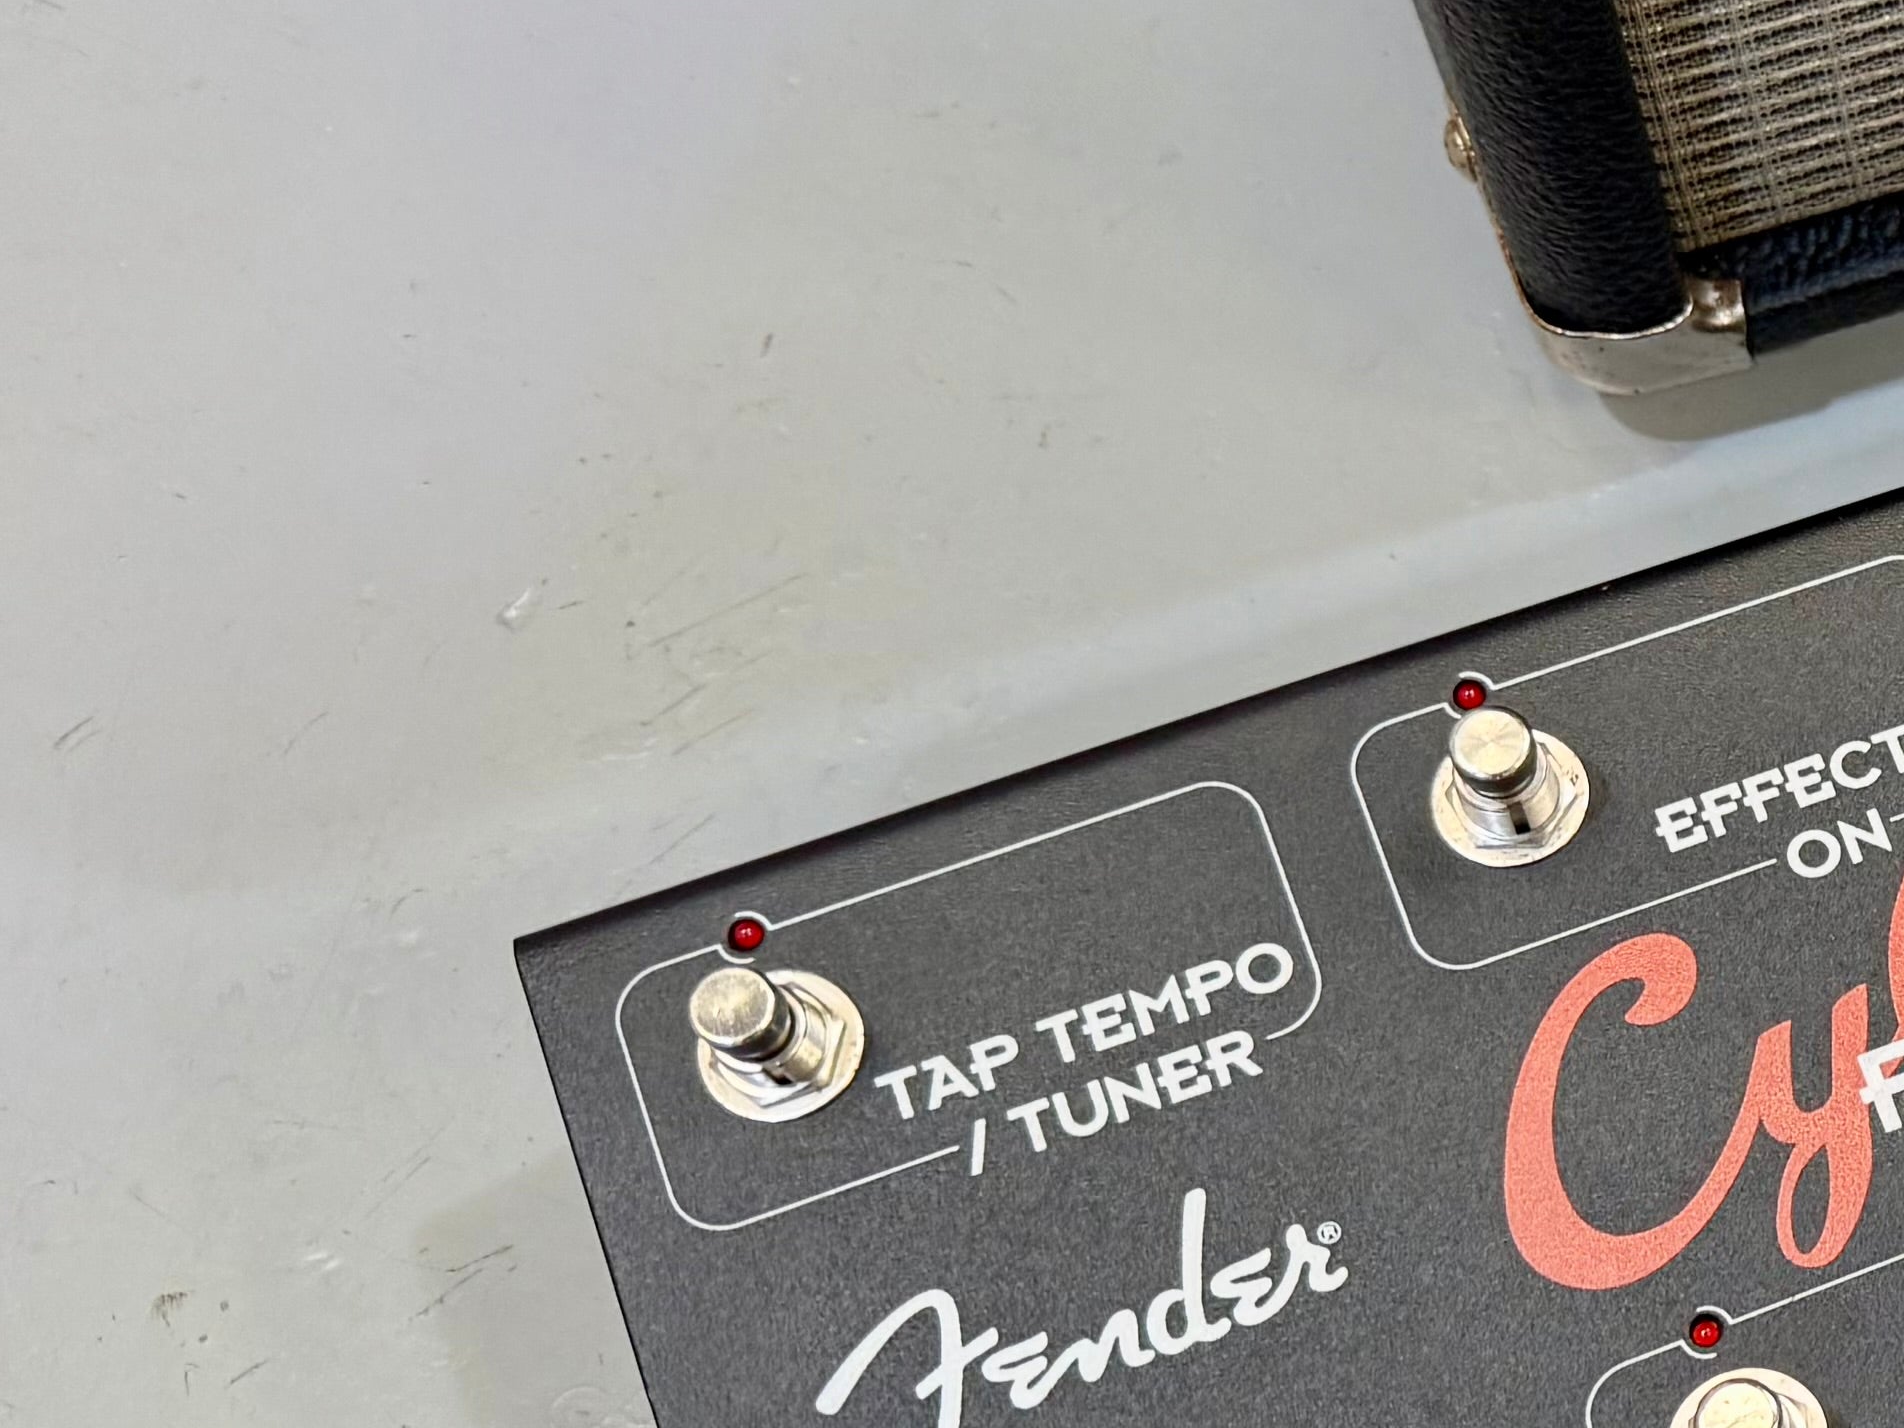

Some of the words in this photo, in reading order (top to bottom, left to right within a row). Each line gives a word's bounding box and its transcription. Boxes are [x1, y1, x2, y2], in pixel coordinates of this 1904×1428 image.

[1786, 807, 1893, 879] ON
[873, 1033, 1019, 1120] TAP
[1033, 942, 1294, 1064] TEMPO
[1005, 1029, 1264, 1153] TUNER
